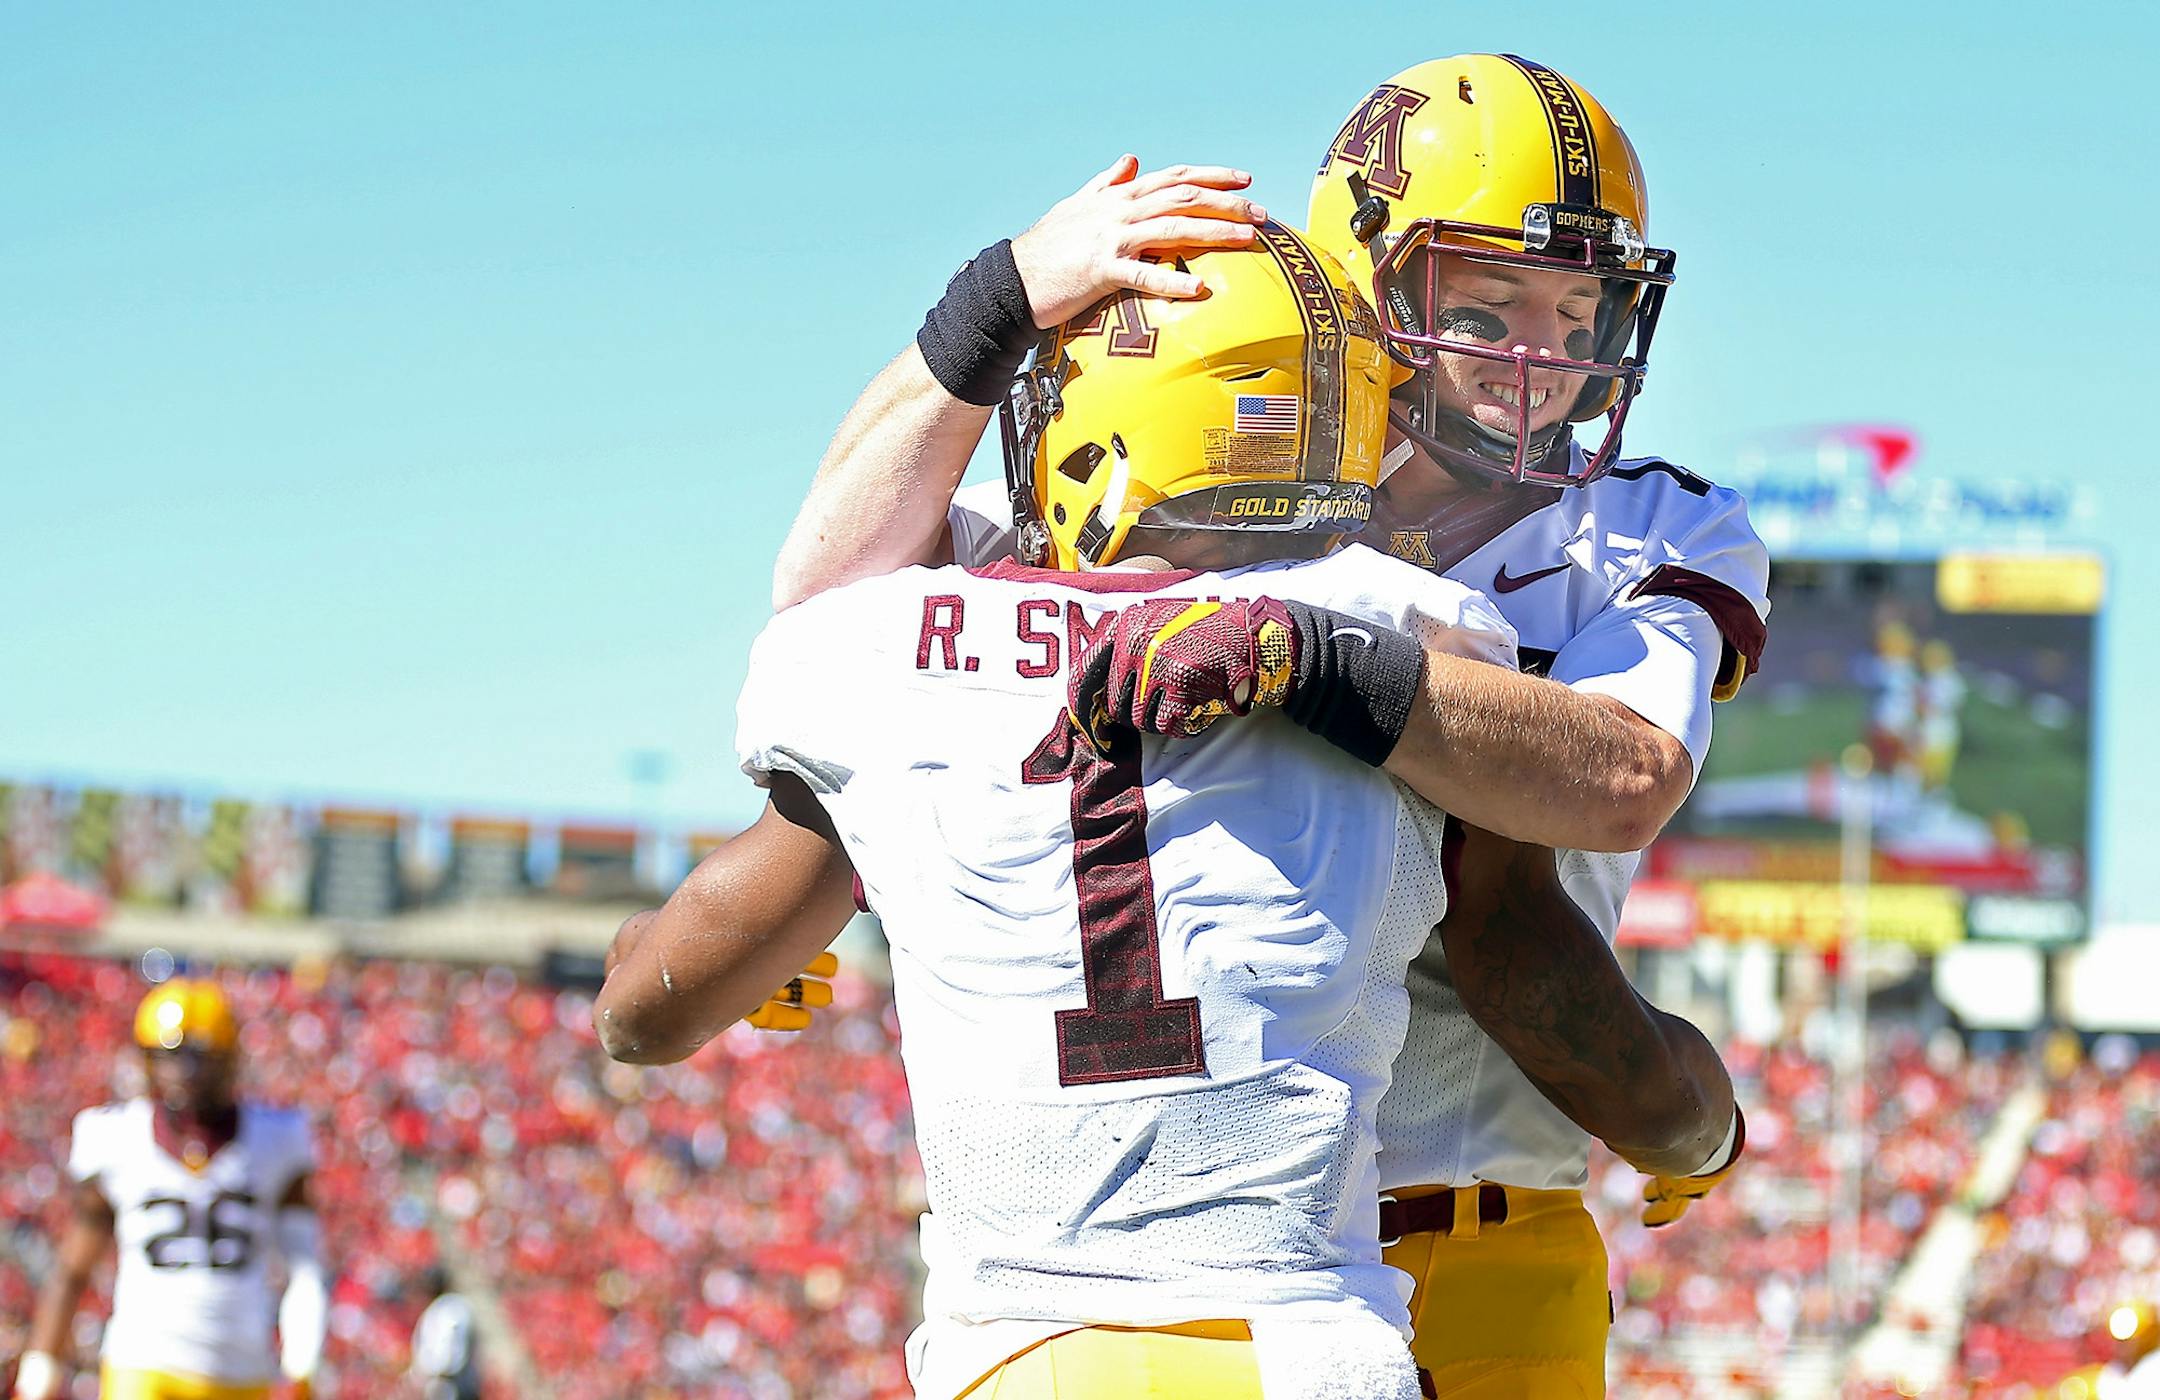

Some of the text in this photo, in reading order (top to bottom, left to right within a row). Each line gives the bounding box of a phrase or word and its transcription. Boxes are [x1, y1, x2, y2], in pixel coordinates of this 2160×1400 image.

[1316, 84, 1431, 200] M
[1532, 69, 1588, 177] SKI-U-MAH
[1556, 211, 1608, 232] GOPHERS
[1229, 497, 1371, 522] GOLD STANDARD
[1387, 530, 1437, 568] M
[916, 594, 980, 671] R.
[1022, 705, 1205, 1087] 1
[141, 1191, 257, 1270] 26
